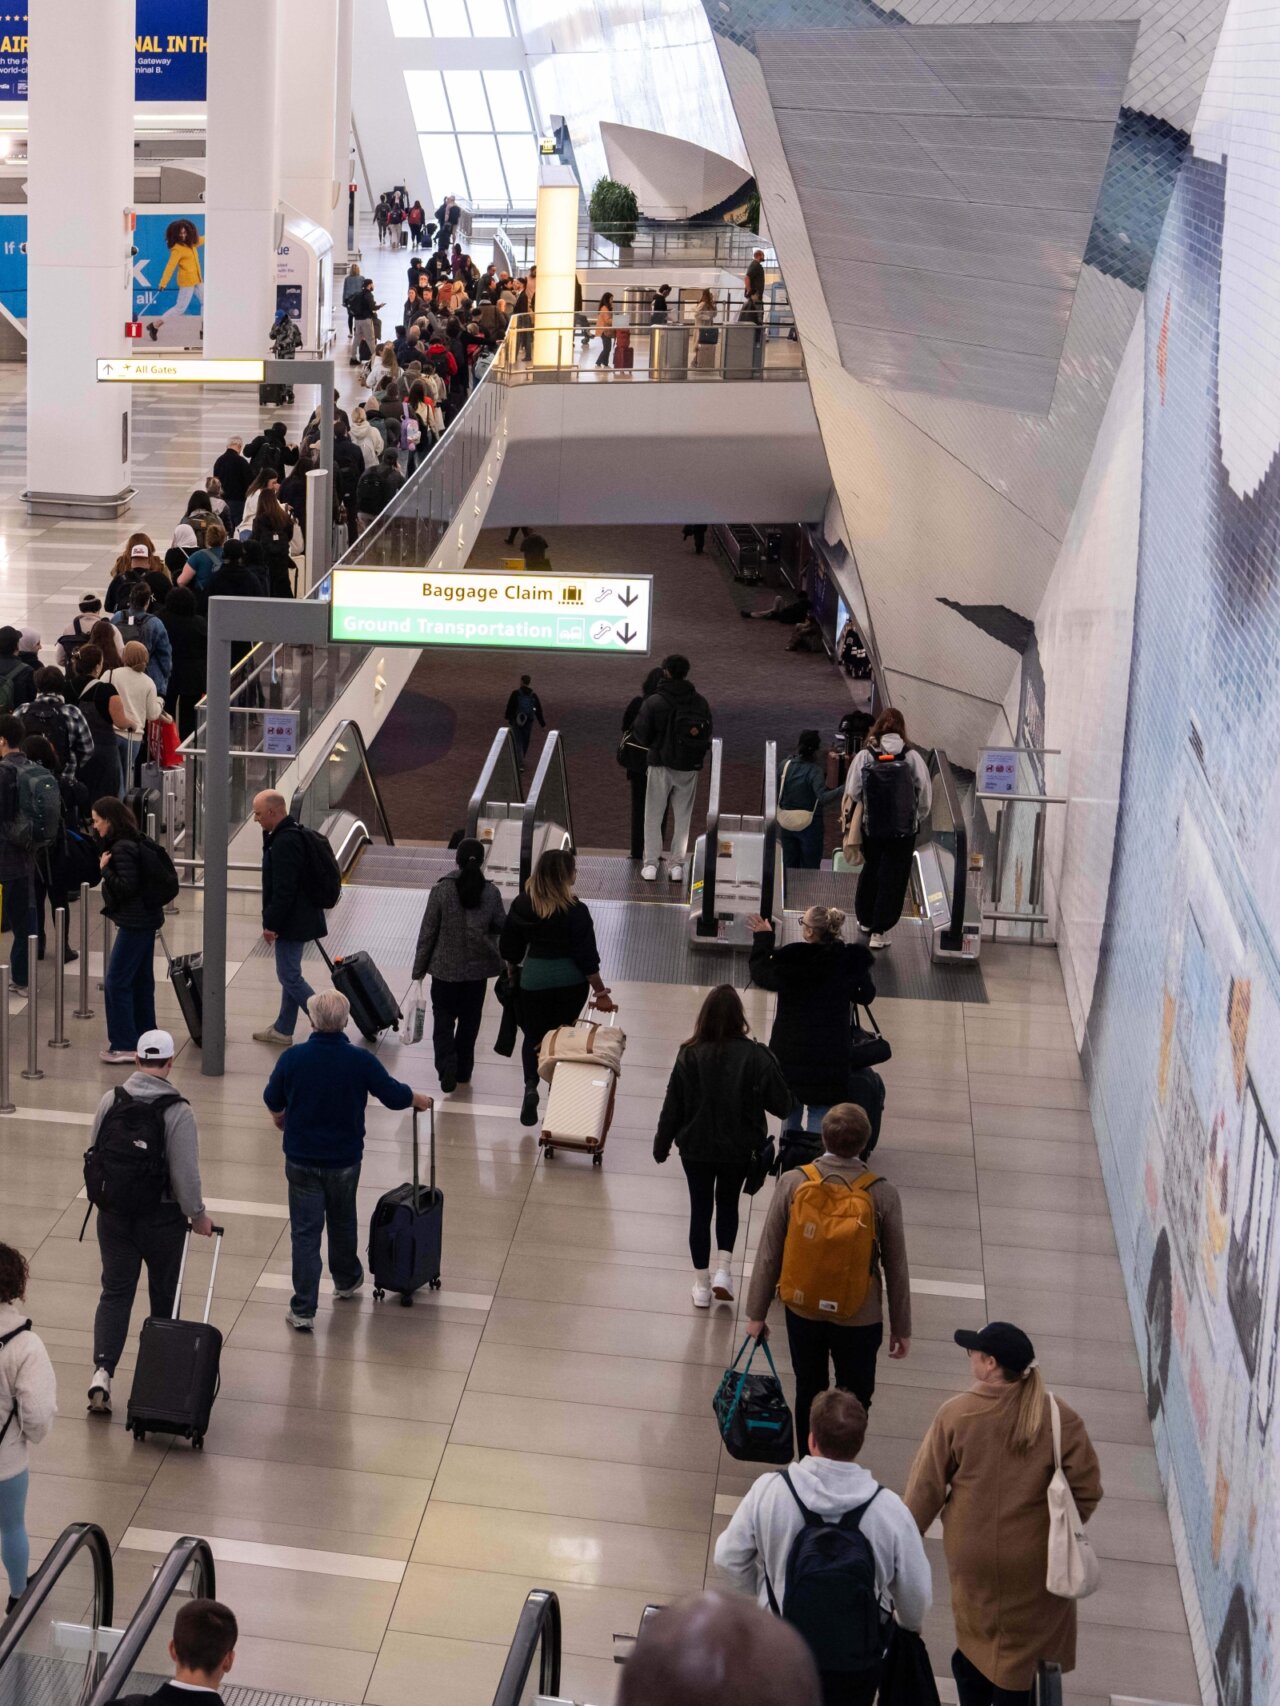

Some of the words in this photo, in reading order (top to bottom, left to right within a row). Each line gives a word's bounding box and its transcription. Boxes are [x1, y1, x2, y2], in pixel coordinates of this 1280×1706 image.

[167, 36, 187, 53] IN
[7, 57, 20, 65] the
[138, 57, 172, 66] Gateway
[4, 241, 16, 255] If
[136, 291, 157, 305] all.
[136, 365, 148, 374] All
[150, 365, 177, 374] Gates
[422, 583, 498, 602] Baggage
[505, 585, 553, 601] Claim
[343, 615, 411, 634] Ground
[416, 617, 553, 639] Transportation
